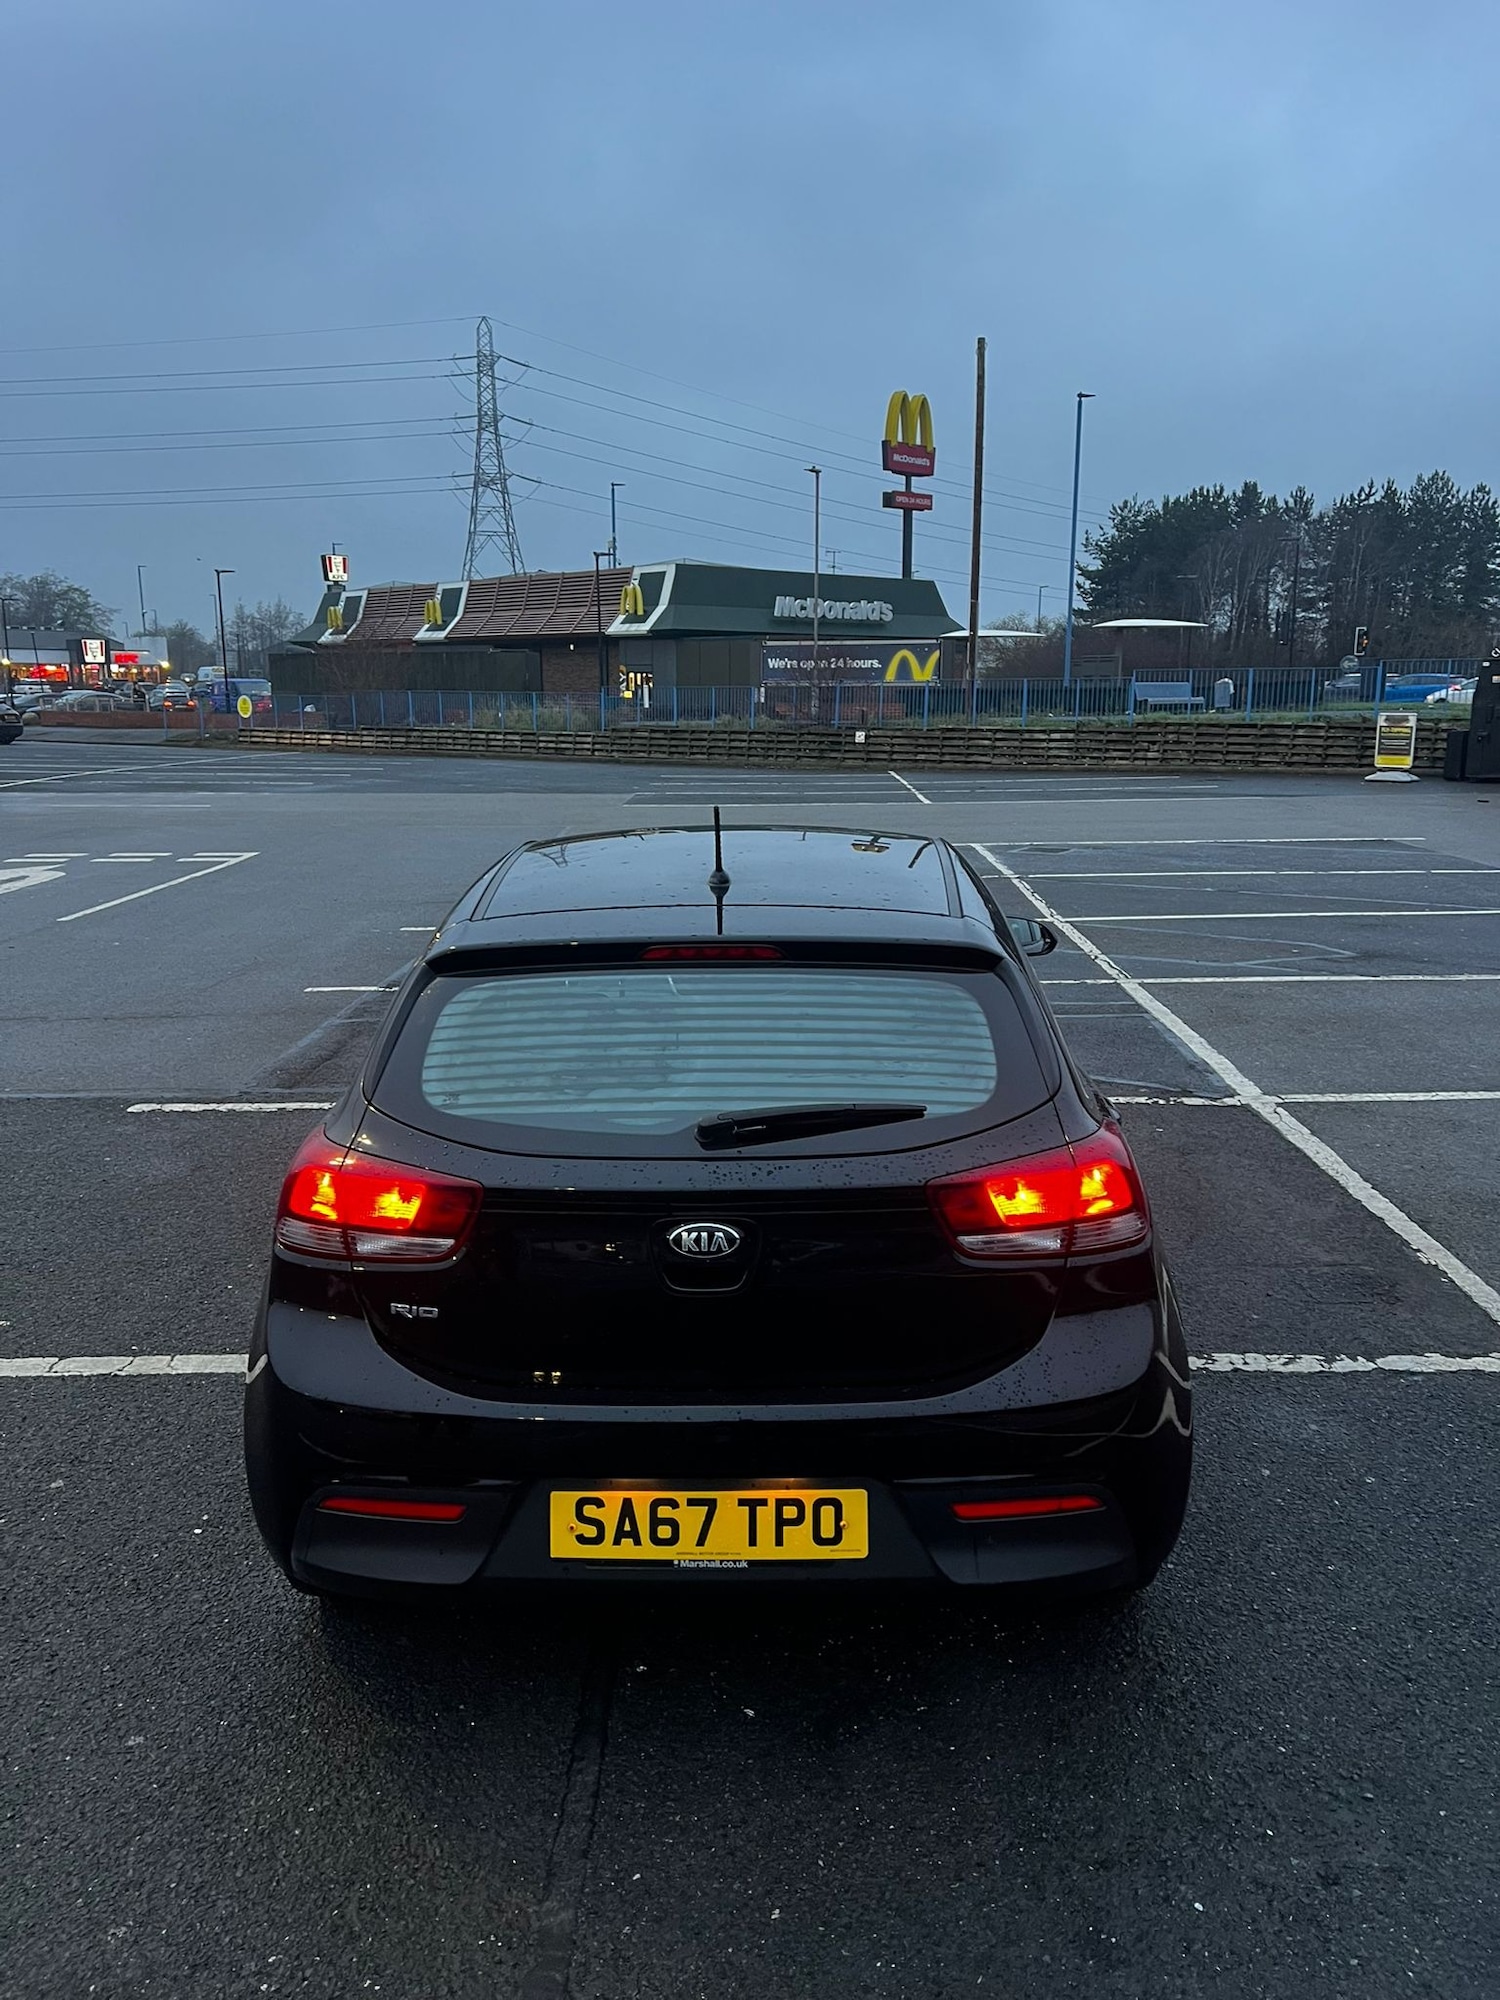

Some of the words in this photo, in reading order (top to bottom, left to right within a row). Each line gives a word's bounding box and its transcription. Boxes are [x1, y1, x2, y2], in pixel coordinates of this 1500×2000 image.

[892, 452, 930, 466] McDonald's
[774, 595, 894, 622] McDonald's
[767, 658, 797, 669] We're
[799, 659, 828, 671] opn
[830, 657, 845, 669] 24
[846, 657, 882, 669] hours.
[681, 1231, 730, 1252] KIA
[390, 1302, 438, 1318] RIO
[574, 1496, 718, 1547] SA67
[737, 1496, 844, 1548] TPO
[679, 1560, 749, 1569] Marshall.co.uk
